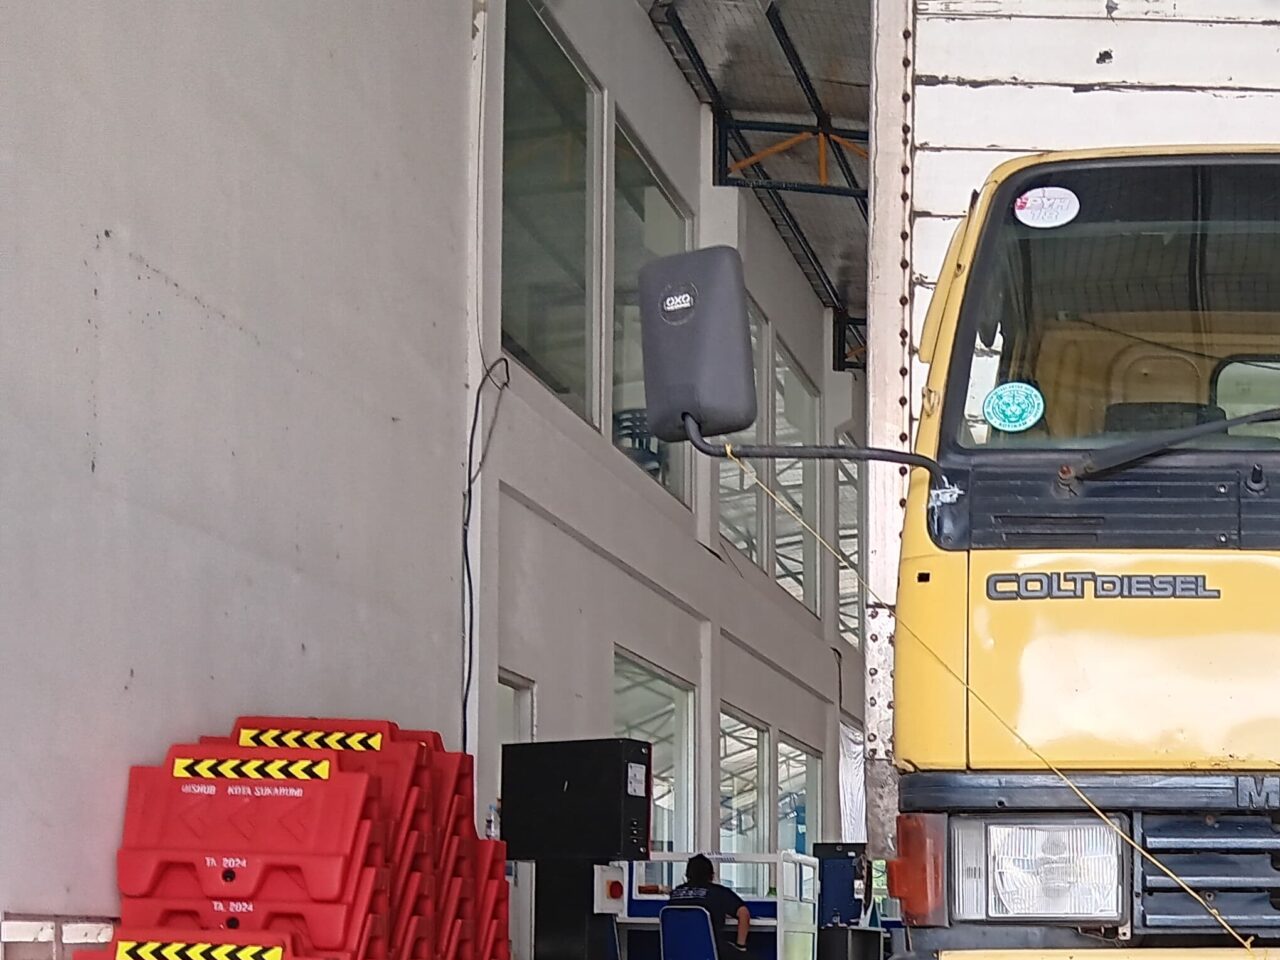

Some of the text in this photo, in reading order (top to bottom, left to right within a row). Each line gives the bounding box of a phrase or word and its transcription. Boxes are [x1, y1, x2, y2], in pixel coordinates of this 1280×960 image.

[666, 293, 690, 307] OXO
[222, 857, 247, 868] 2024
[229, 902, 253, 912] 2024
